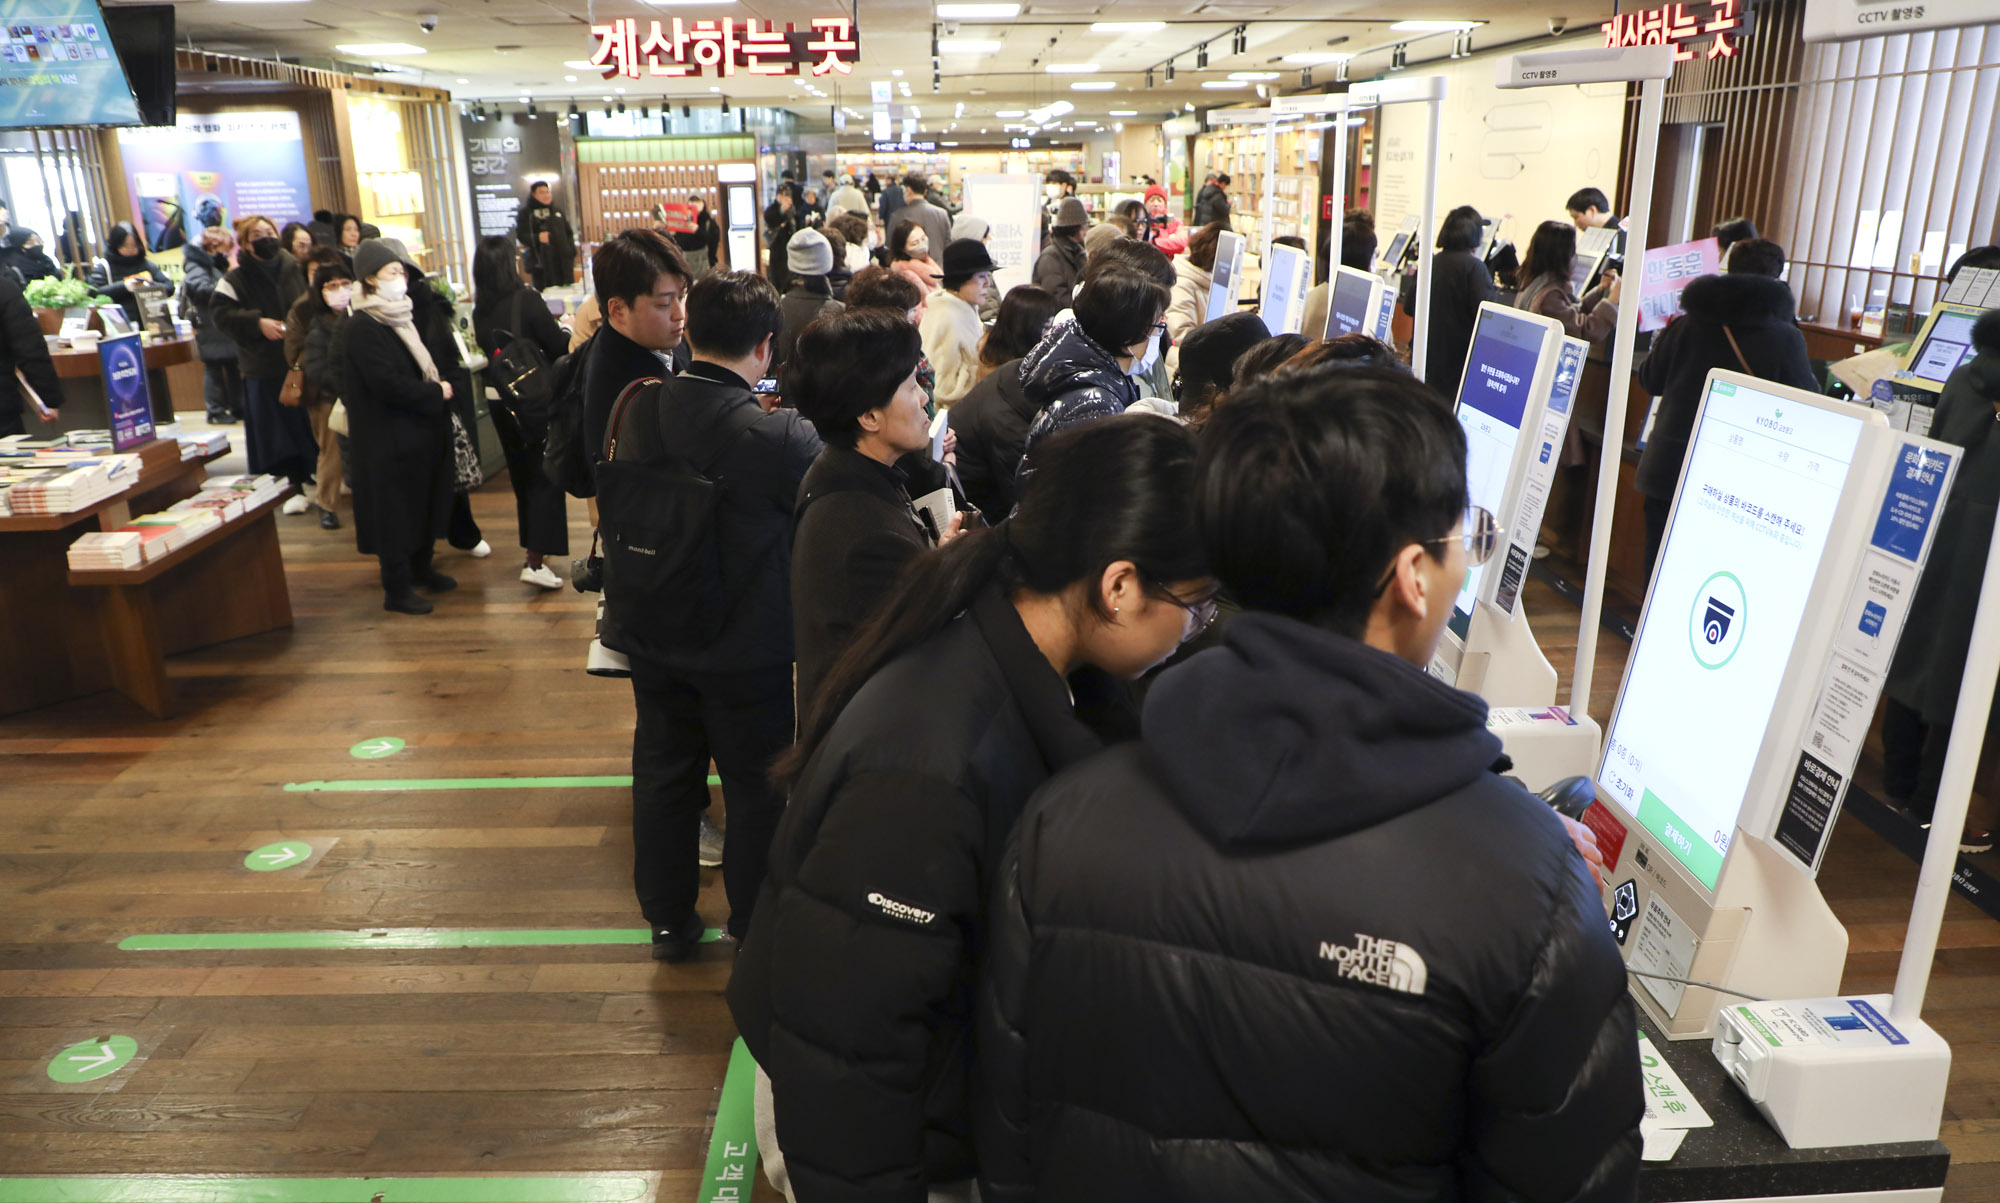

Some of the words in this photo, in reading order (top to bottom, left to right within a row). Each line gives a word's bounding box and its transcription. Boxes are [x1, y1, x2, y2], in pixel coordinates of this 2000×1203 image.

[1705, 0, 1736, 60] 곳
[1858, 10, 1888, 24] CCTV
[1891, 6, 1924, 21] 촬영중
[591, 17, 790, 77] 계산하는
[807, 17, 857, 75] 곳
[1522, 72, 1538, 80] CCTV
[1540, 70, 1557, 78] 촬영중
[471, 156, 506, 174] 공간
[1647, 251, 1704, 284] 한동훈
[1756, 416, 1779, 430] KYOBO
[1729, 433, 1744, 446] 상품명
[1778, 451, 1790, 462] 수량
[1808, 460, 1820, 472] 가격
[1904, 451, 1945, 474] 문화리카드
[1920, 470, 1936, 486] 안내
[1702, 484, 1723, 502] 구매하실
[1723, 494, 1740, 508] 상품의
[1741, 501, 1764, 519] 바코드를
[1764, 512, 1783, 527] 스캔해
[1783, 518, 1805, 536] 주세요!
[1617, 744, 1627, 760] 0종
[1628, 752, 1643, 774] (0개)
[1616, 777, 1635, 800] 초기화
[1804, 759, 1828, 782] 바로결제
[1826, 774, 1840, 790] 안내
[1664, 822, 1692, 856] 결제하기
[1320, 942, 1392, 975] NORTH
[1354, 932, 1395, 957] THE
[1338, 961, 1388, 986] FACE
[1642, 1072, 1677, 1097] 스캔
[1663, 1100, 1687, 1114] 후
[710, 1141, 748, 1203] 고객대
